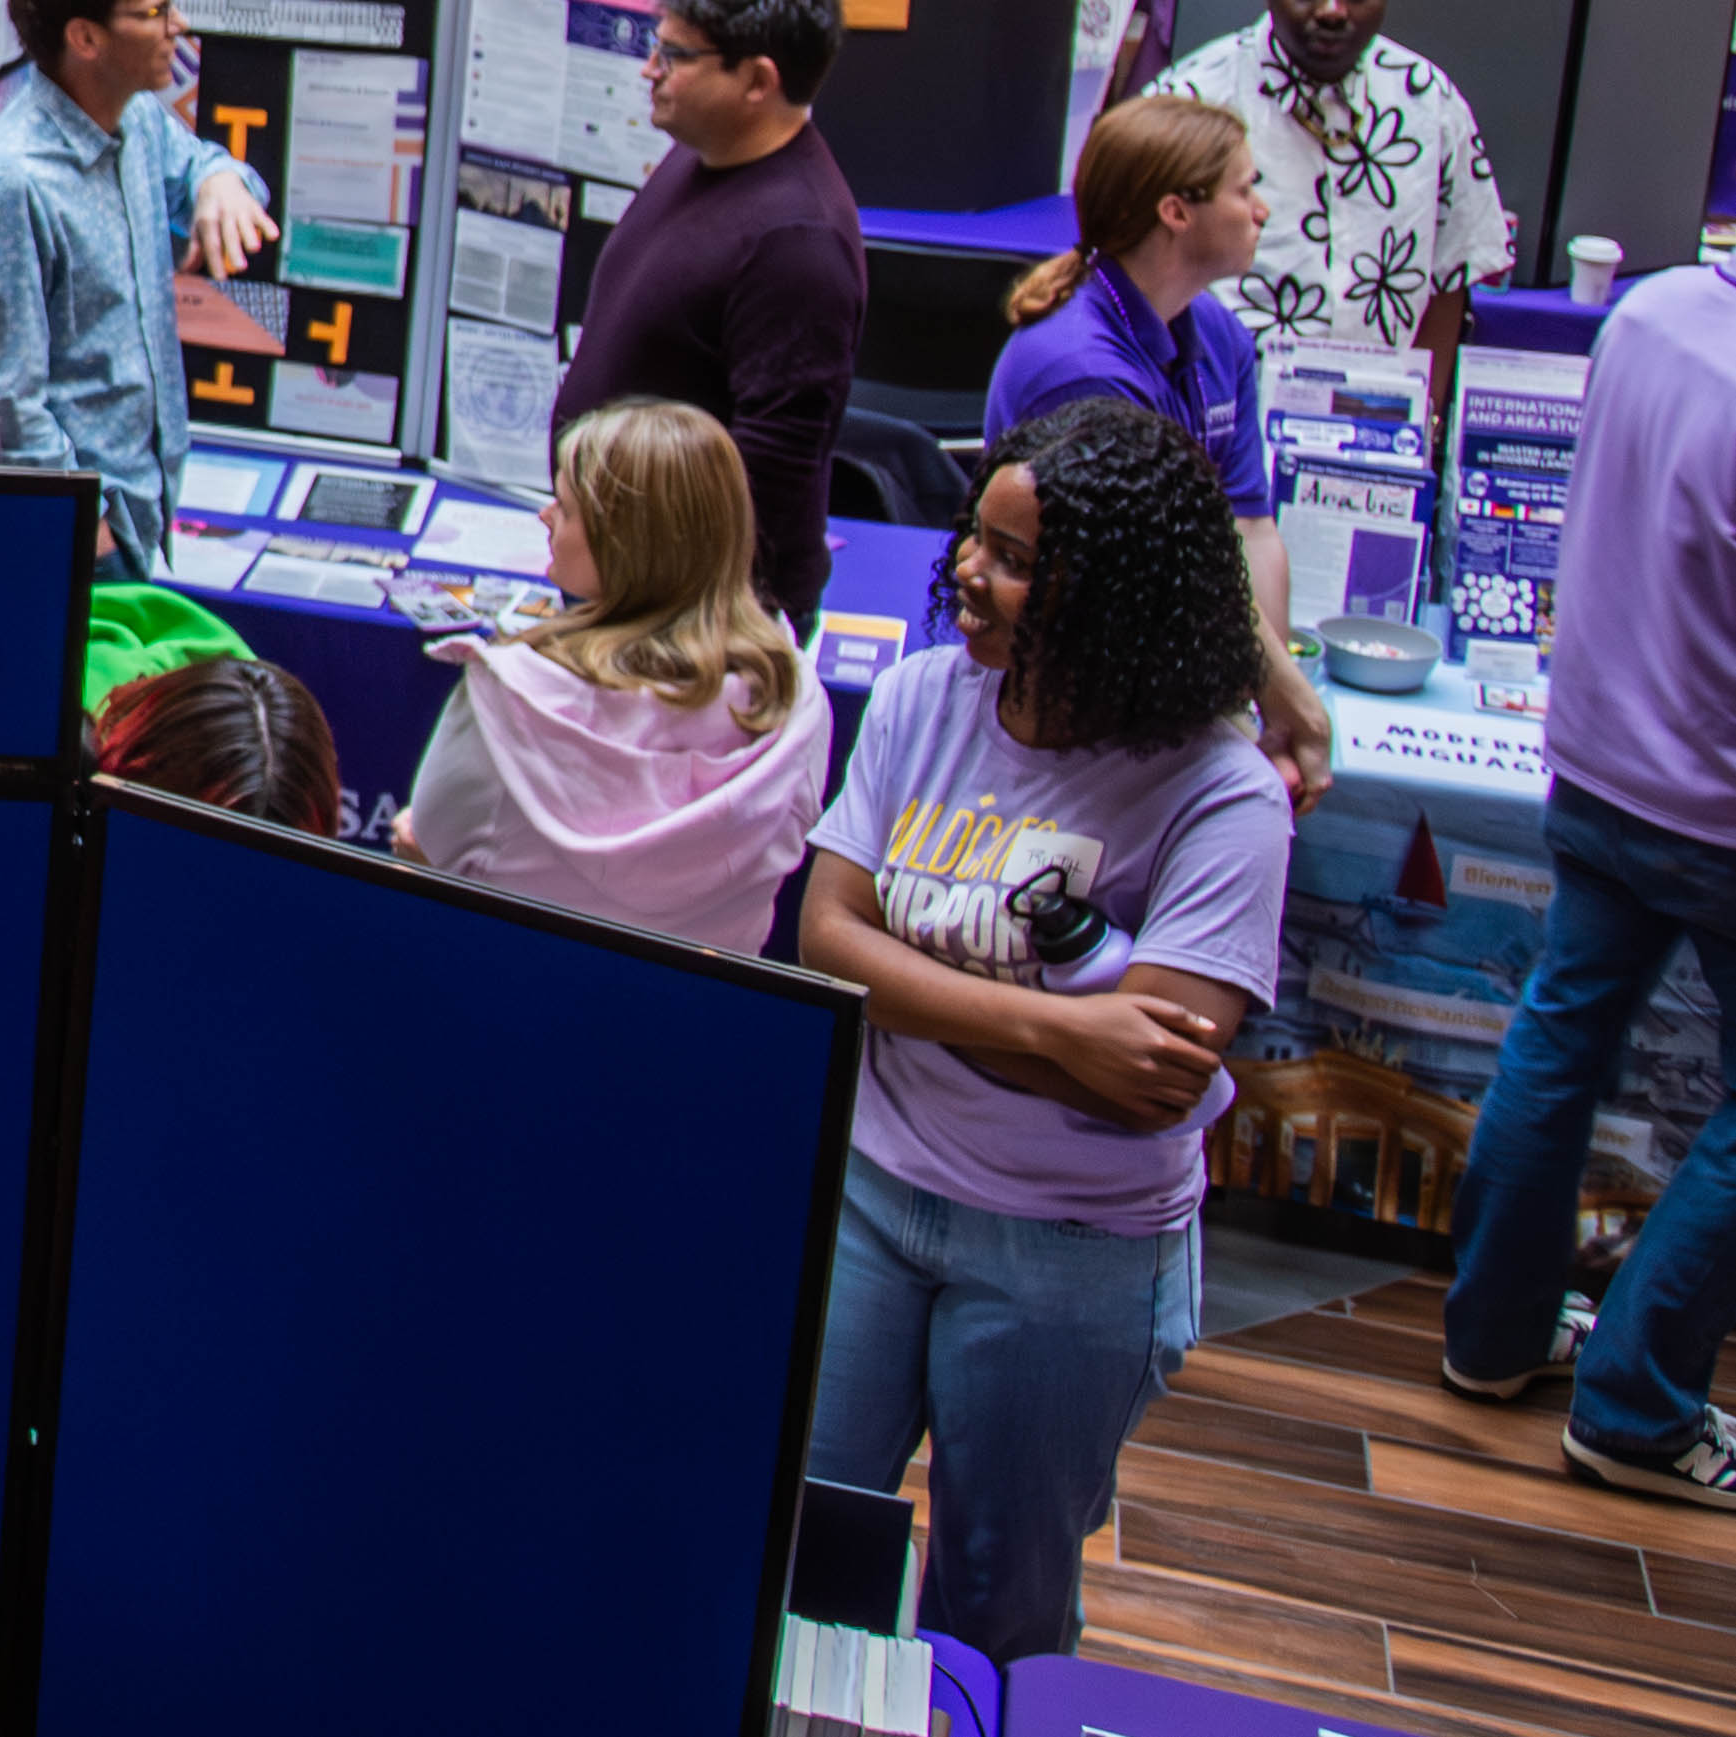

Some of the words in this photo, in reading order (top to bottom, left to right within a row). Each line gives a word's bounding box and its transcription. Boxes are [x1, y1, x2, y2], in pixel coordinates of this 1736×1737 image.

[1466, 410, 1502, 426] AND
[1504, 413, 1548, 431] AREA
[1299, 478, 1405, 518] Arabic
[1386, 723, 1546, 759] MODERN
